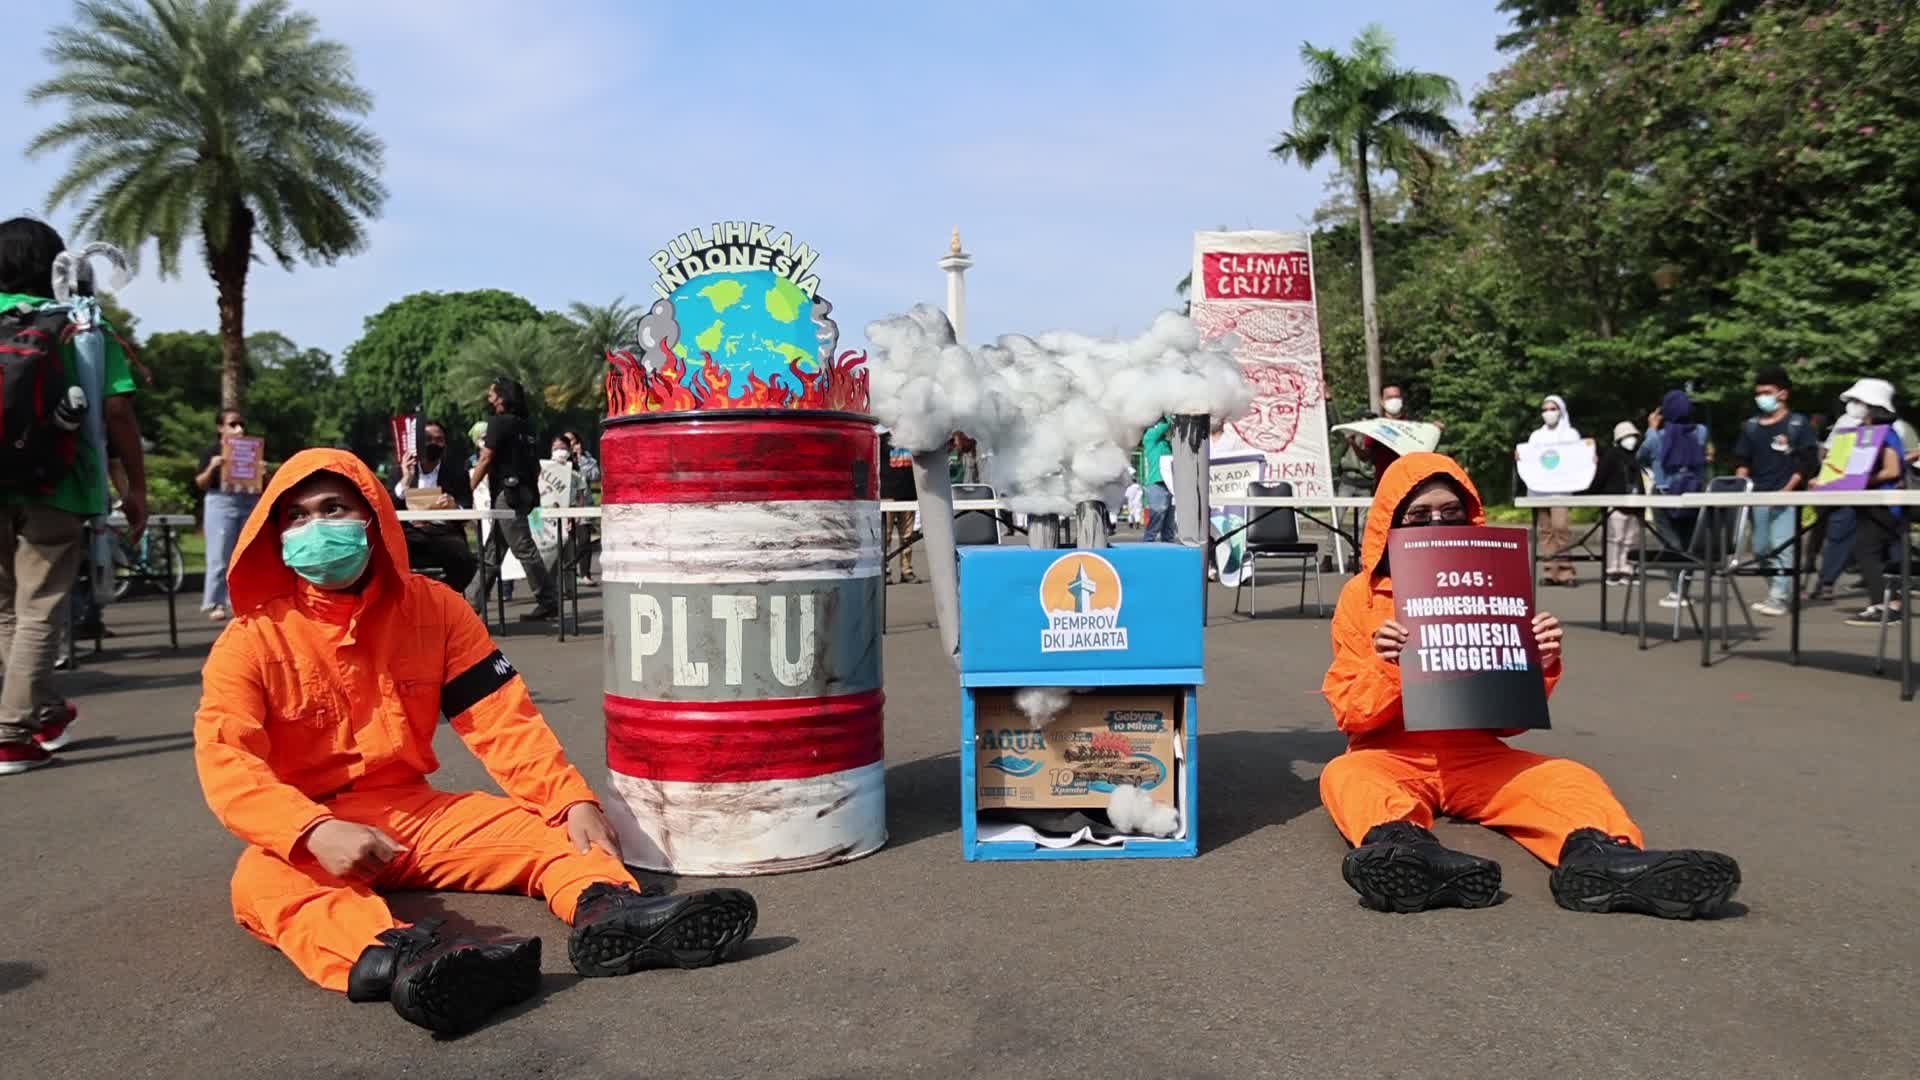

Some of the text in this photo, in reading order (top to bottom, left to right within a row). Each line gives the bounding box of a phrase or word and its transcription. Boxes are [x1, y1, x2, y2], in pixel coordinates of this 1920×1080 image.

[649, 221, 820, 276] PULIHKAN
[651, 246, 821, 300] INDONESIA
[1219, 256, 1308, 276] CLIMATE
[1218, 275, 1293, 295] CRISIS
[1225, 469, 1252, 481] ADA
[1436, 571, 1493, 587] 2045:
[1406, 596, 1526, 617] INDONESIA EMAS
[1053, 615, 1114, 630] PEMPROV
[630, 593, 815, 687] PLTU
[1043, 631, 1125, 648] DKI JAKARTA
[1420, 623, 1521, 647] INDONESIA
[1418, 648, 1528, 672] TENGGELAM
[981, 729, 1046, 754] AQUA
[1049, 768, 1074, 786] 10
